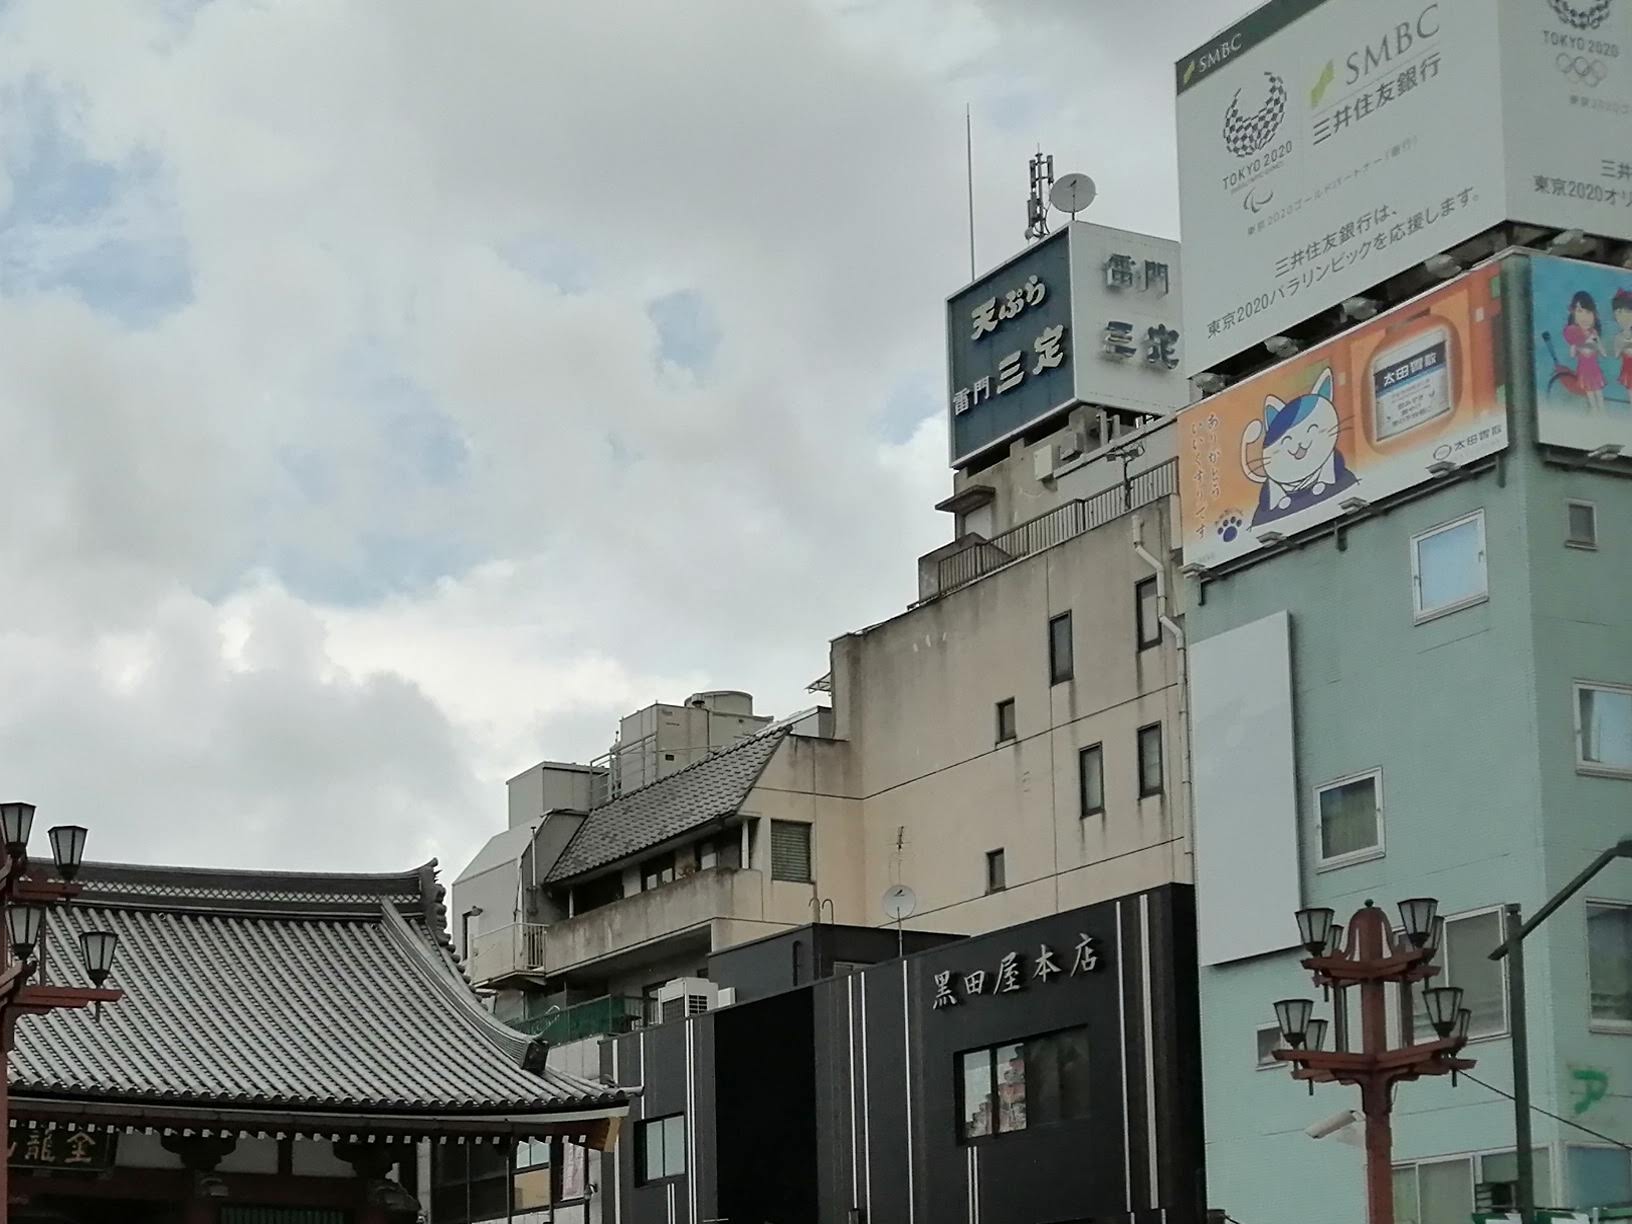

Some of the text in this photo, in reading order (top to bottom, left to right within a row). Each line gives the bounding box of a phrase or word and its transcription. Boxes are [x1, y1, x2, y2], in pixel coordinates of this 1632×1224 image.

[1198, 33, 1243, 74] SMBC
[1344, 4, 1441, 87] SMBC
[1543, 30, 1620, 58] TOKYO 2020
[1312, 53, 1442, 146] 三井住友銀行
[1221, 157, 1262, 191] TOKYO
[1263, 140, 1294, 173] 2020
[1273, 203, 1399, 279] 三井住友銀行は、
[971, 275, 1046, 340] 天ぷら
[932, 932, 1099, 1010] 黒田屋本店
